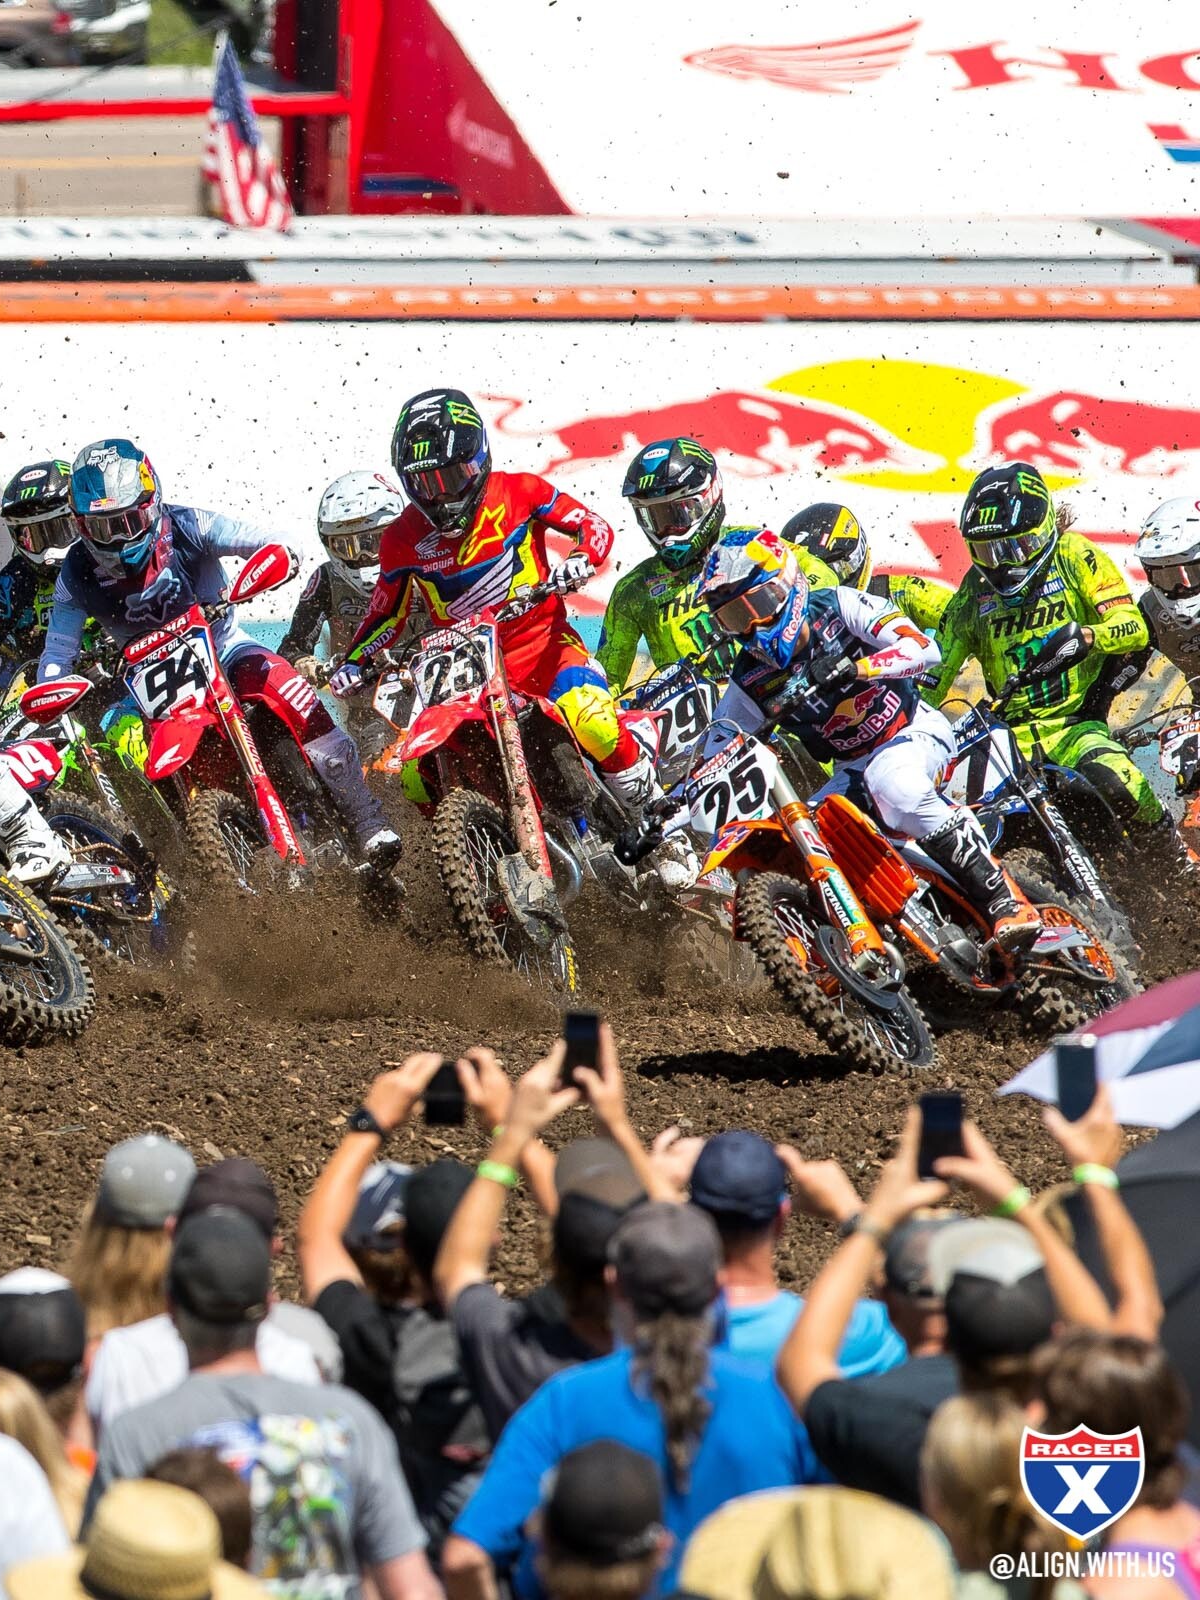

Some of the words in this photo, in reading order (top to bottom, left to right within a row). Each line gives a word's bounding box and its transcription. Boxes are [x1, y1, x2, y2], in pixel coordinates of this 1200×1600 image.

[403, 458, 438, 471] MONSTER
[966, 524, 1003, 534] MONSTER
[416, 548, 453, 561] HONDA
[422, 557, 454, 573] SHOWA
[989, 601, 1067, 642] THOR
[1108, 620, 1140, 641] THOR
[144, 648, 208, 719] 94
[830, 724, 879, 752] Red
[864, 690, 901, 734] Bull
[704, 754, 772, 835] 25
[1063, 844, 1105, 901] DUNLOP
